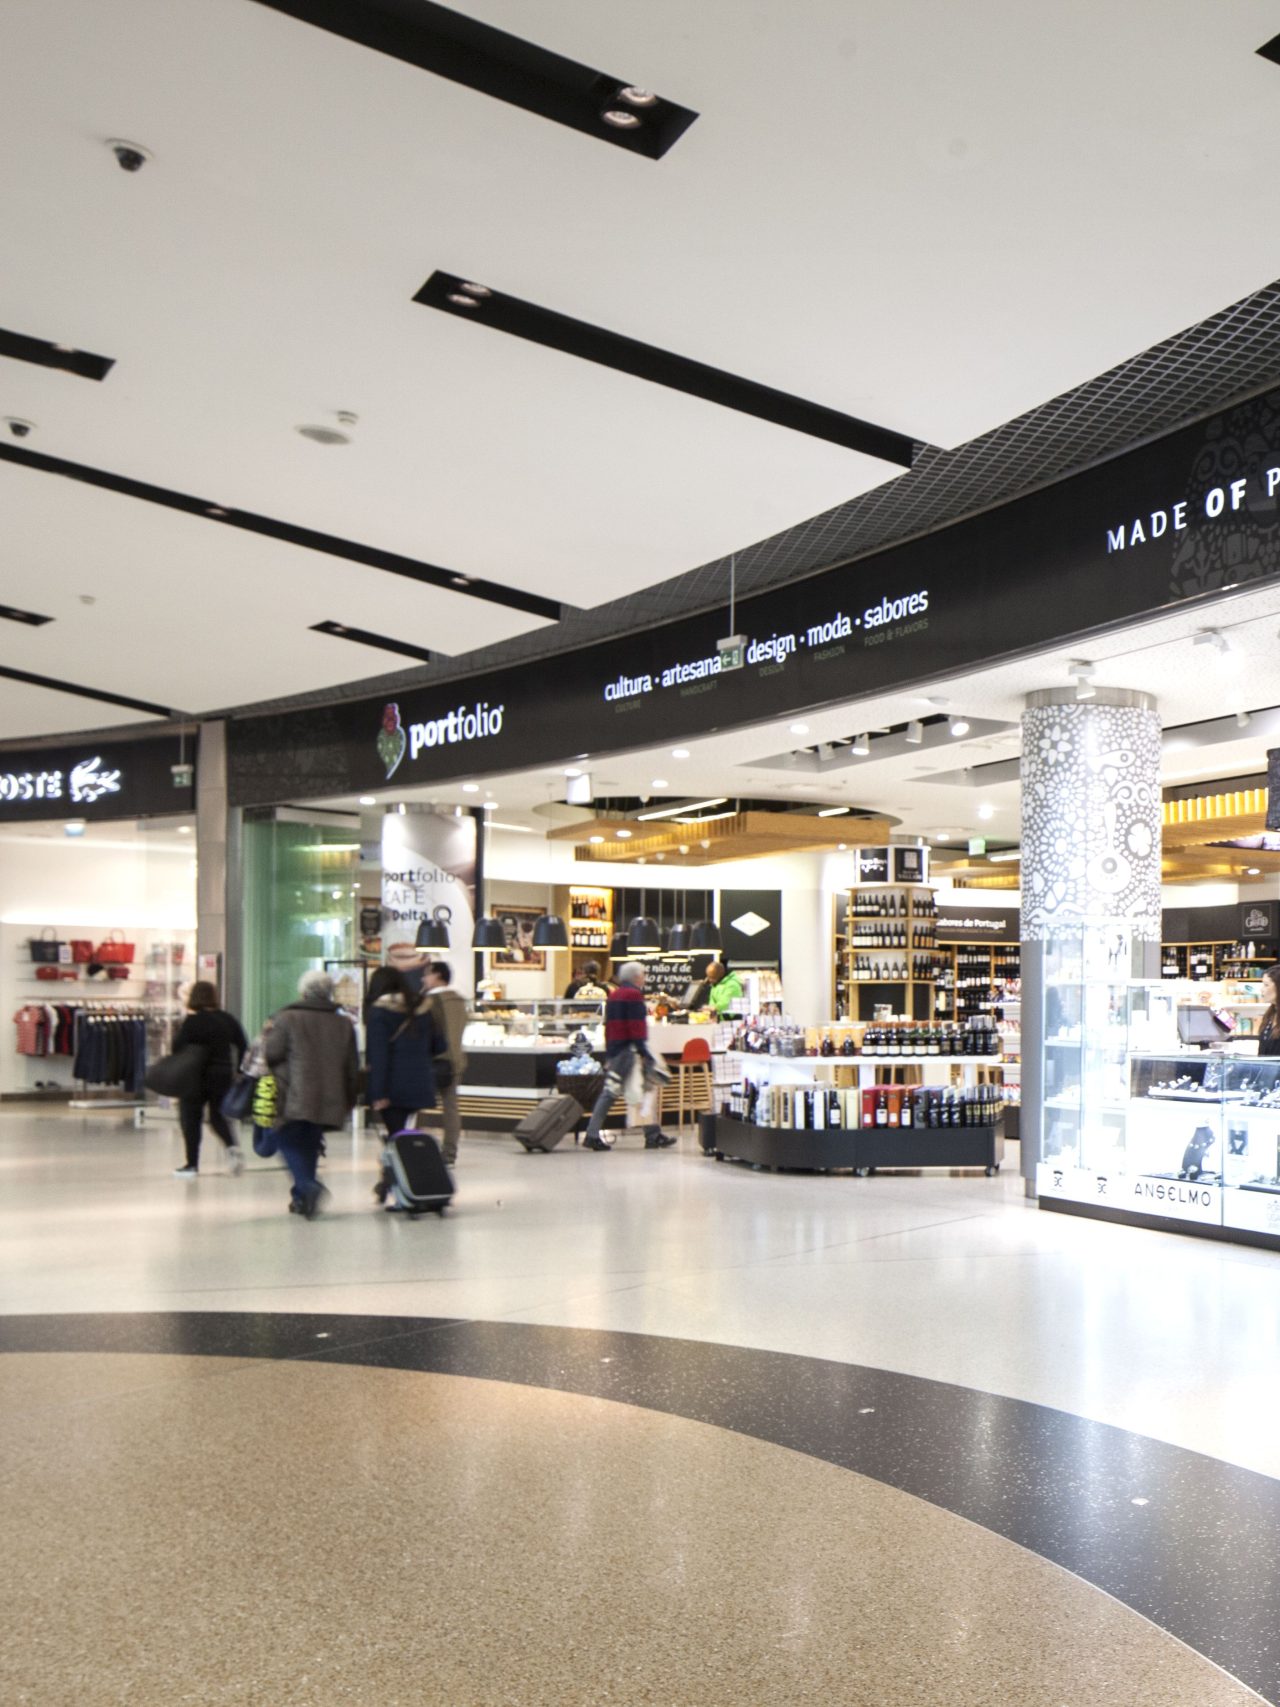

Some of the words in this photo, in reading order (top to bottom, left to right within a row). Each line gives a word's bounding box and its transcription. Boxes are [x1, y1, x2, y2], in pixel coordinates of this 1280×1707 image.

[1106, 501, 1188, 554] MADE
[1205, 478, 1247, 518] OF
[604, 674, 653, 701] cultura
[661, 655, 722, 687] artesana
[747, 632, 796, 664] design
[806, 612, 852, 647] moda
[863, 590, 929, 629] sabores
[392, 908, 428, 921] Delta
[974, 918, 1007, 930] Portugal
[1134, 1182, 1212, 1207] ANSELMO
